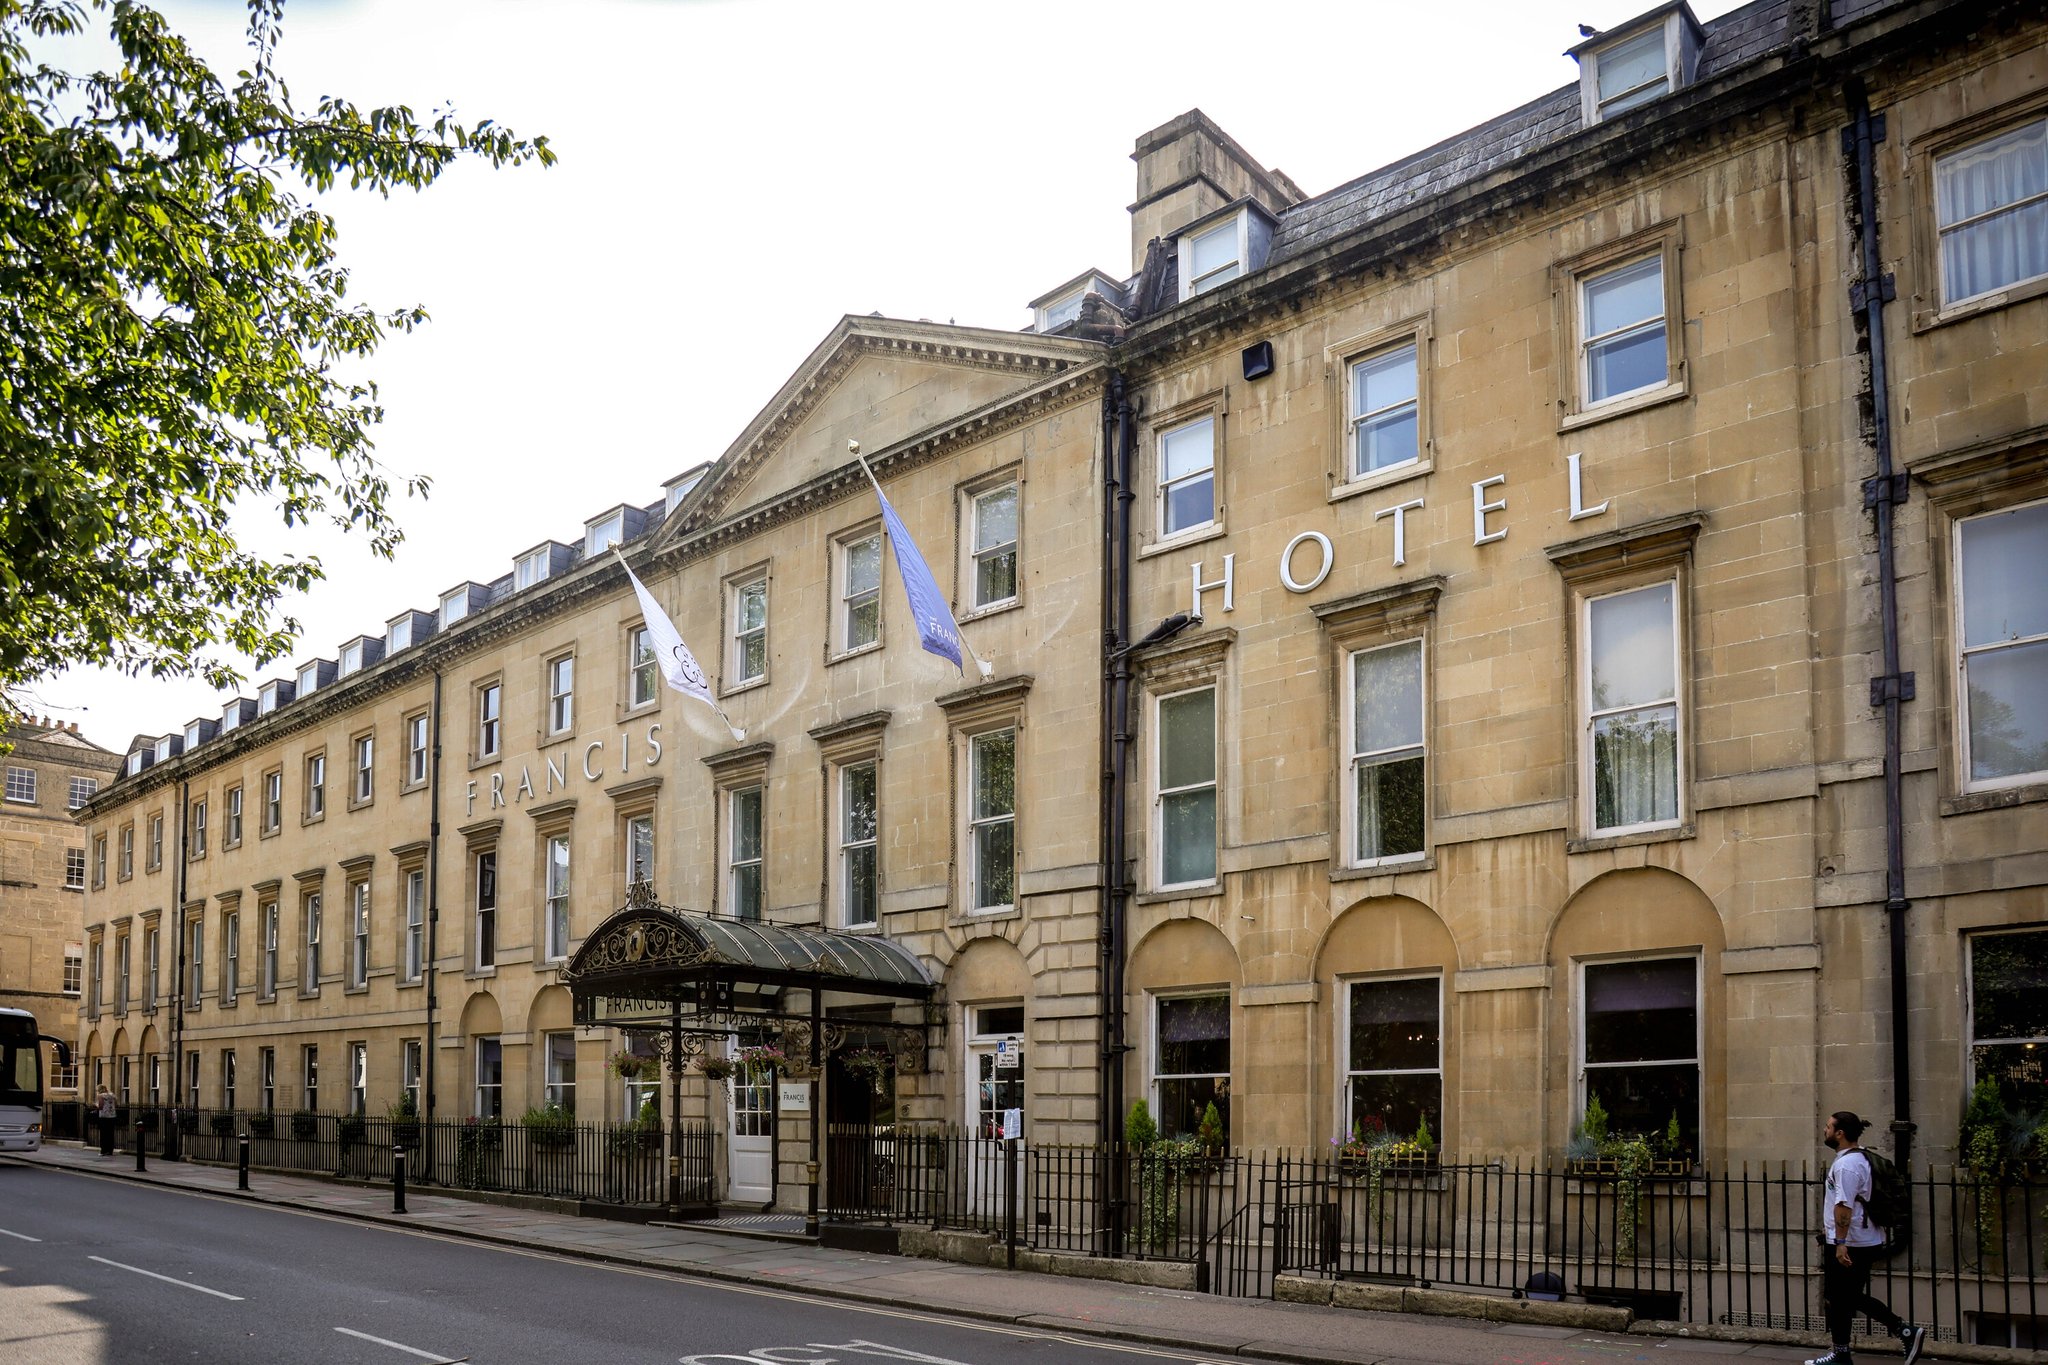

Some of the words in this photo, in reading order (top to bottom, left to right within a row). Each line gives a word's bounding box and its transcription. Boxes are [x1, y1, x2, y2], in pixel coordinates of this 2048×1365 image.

[1190, 452, 1610, 619] HOTEL
[466, 723, 662, 817] FRANCIS
[606, 997, 667, 1014] FRANCIS
